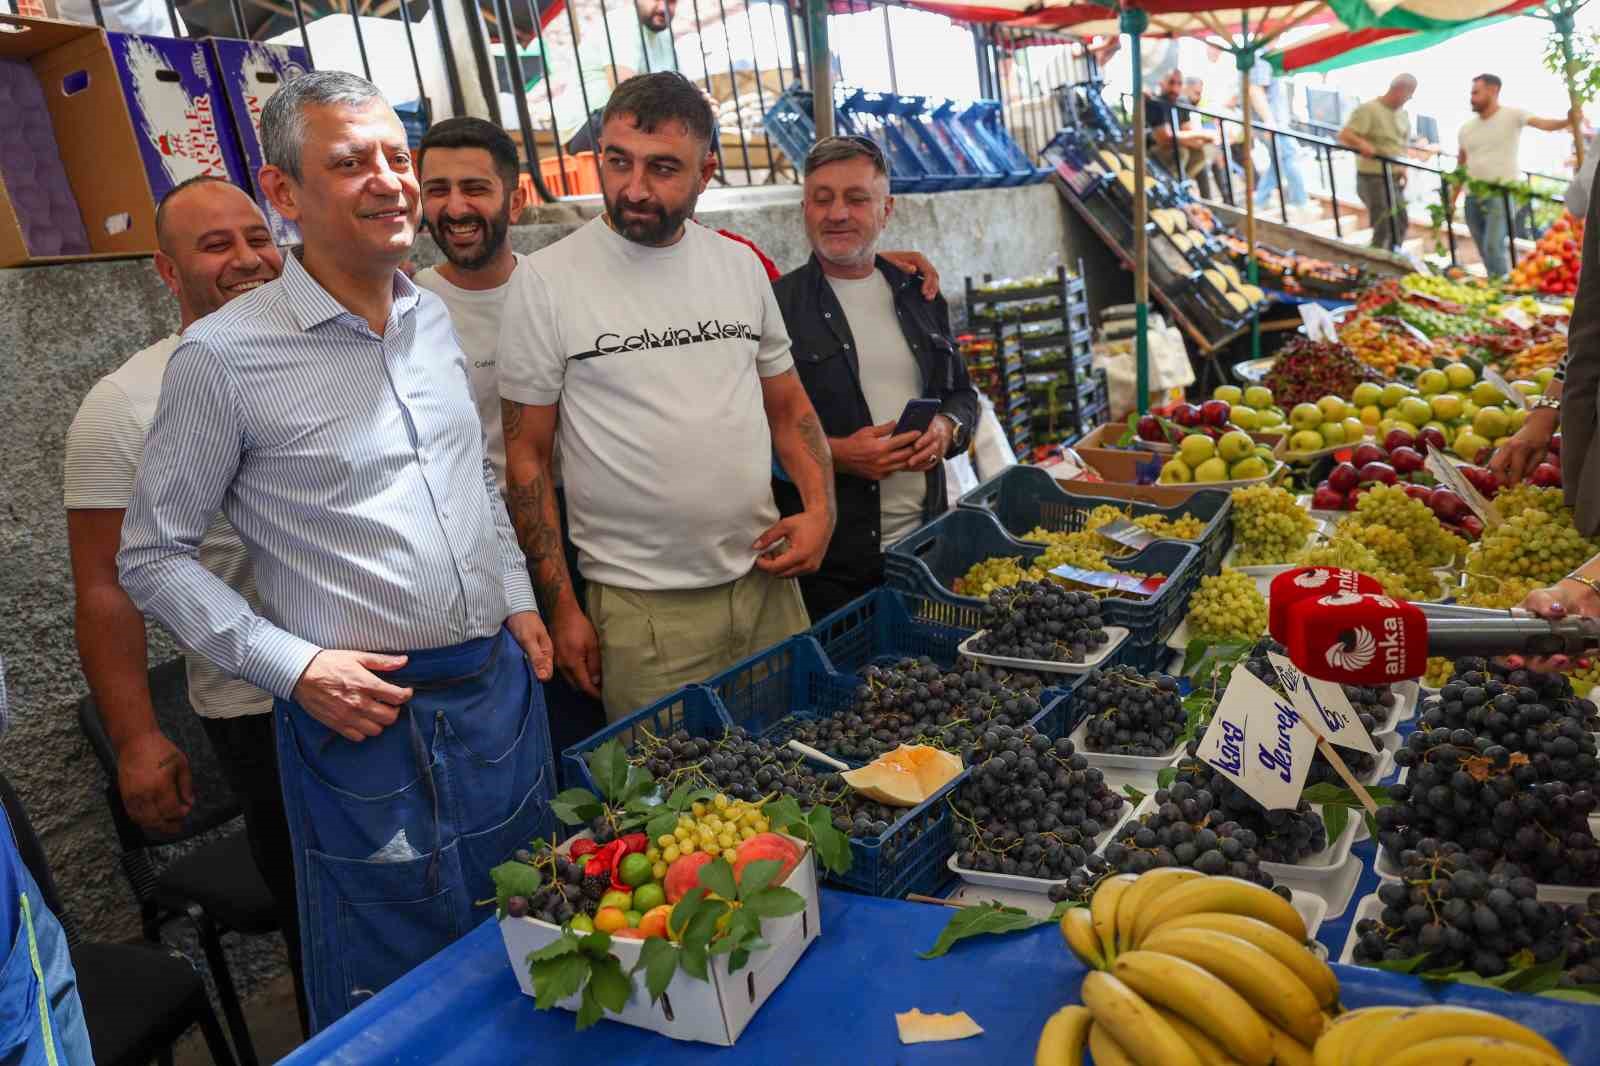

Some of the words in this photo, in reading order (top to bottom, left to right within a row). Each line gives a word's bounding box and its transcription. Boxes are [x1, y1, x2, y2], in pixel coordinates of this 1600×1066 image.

[595, 328, 692, 354] Calvin
[697, 319, 751, 341] Klein
[1378, 616, 1398, 675] anka
